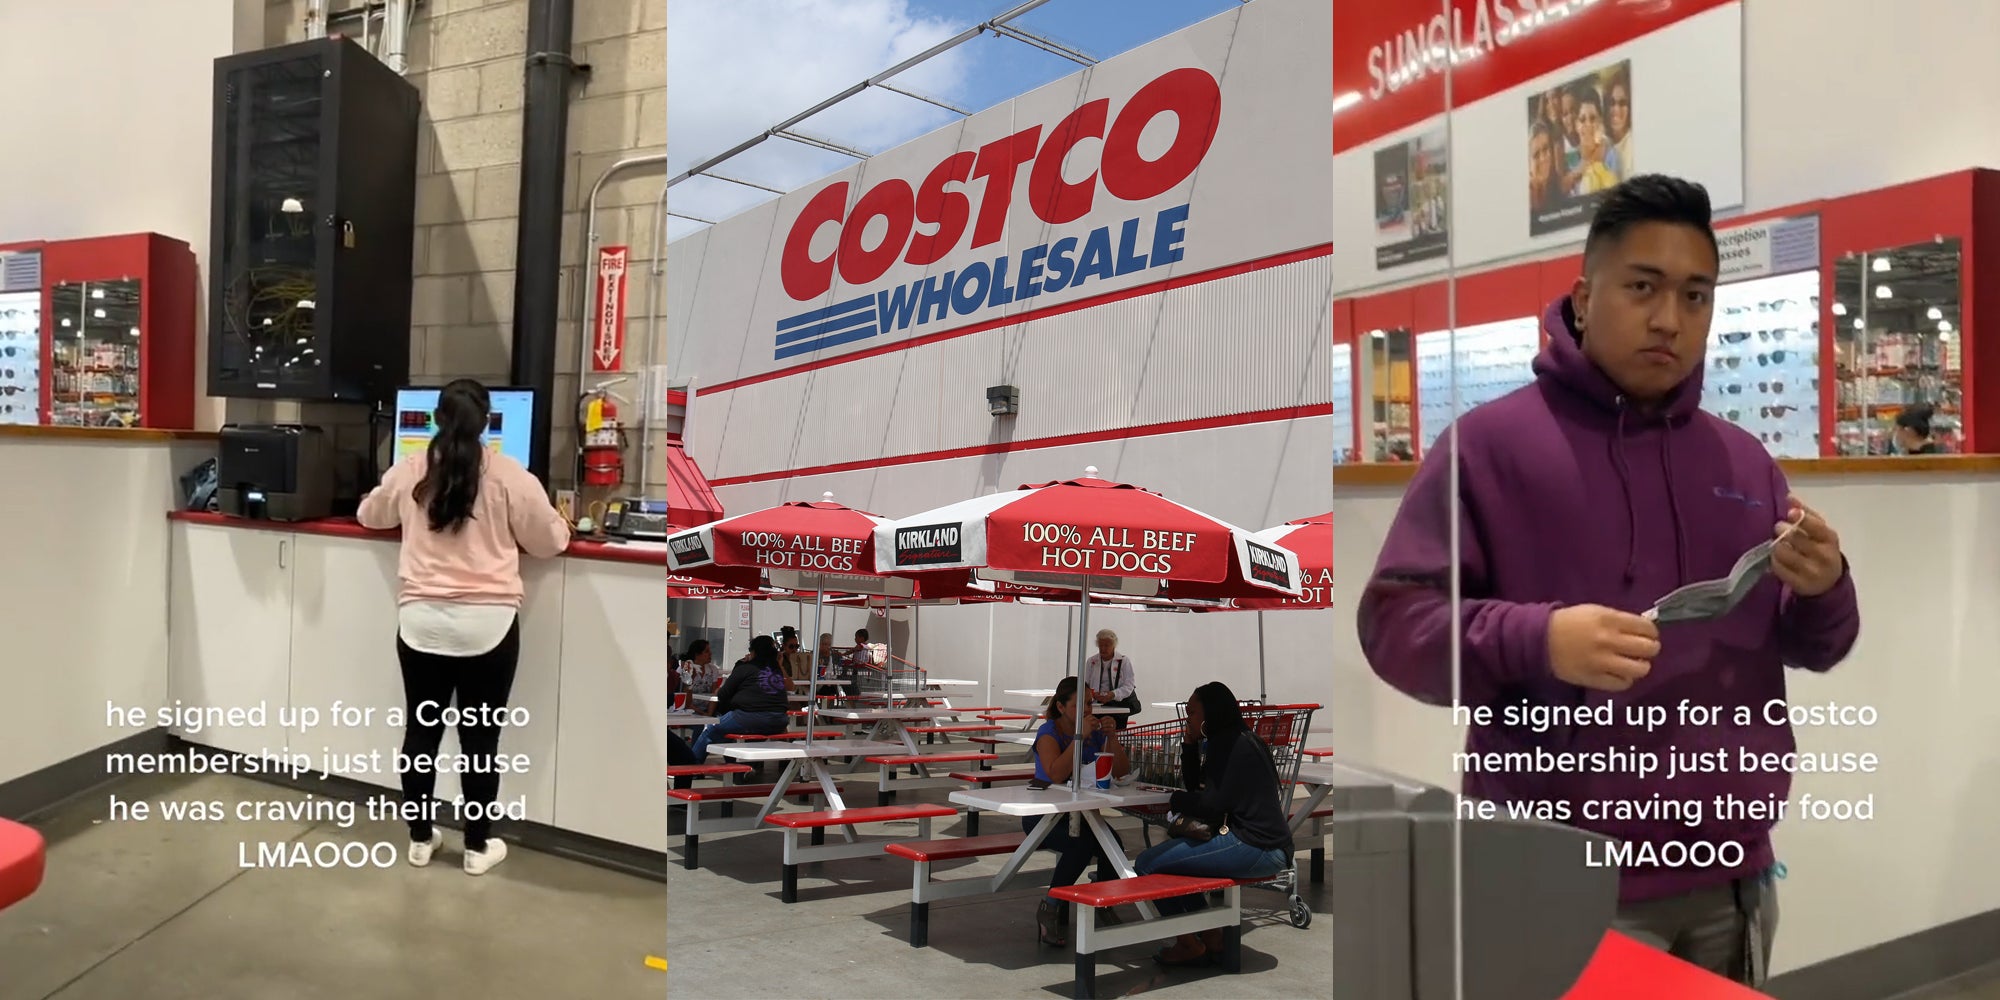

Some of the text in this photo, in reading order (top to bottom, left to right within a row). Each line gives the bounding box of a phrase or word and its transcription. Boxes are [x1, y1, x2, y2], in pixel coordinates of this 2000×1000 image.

[781, 67, 1222, 301] COSTCO
[602, 258, 623, 270] FIRE
[875, 203, 1190, 334] WHOLESALE
[602, 274, 616, 362] EXTINGUISHER
[670, 535, 702, 554] KIRKLAND
[741, 531, 867, 555] 100% ALL BEE
[898, 527, 959, 550] KIRKLAND
[1022, 522, 1197, 552] 100% ALL BEEF
[756, 550, 853, 571] HOT DOGS
[1041, 547, 1172, 574] HOT DOGS
[1249, 544, 1287, 574] KIRKLAND
[1282, 587, 1324, 603] OT
